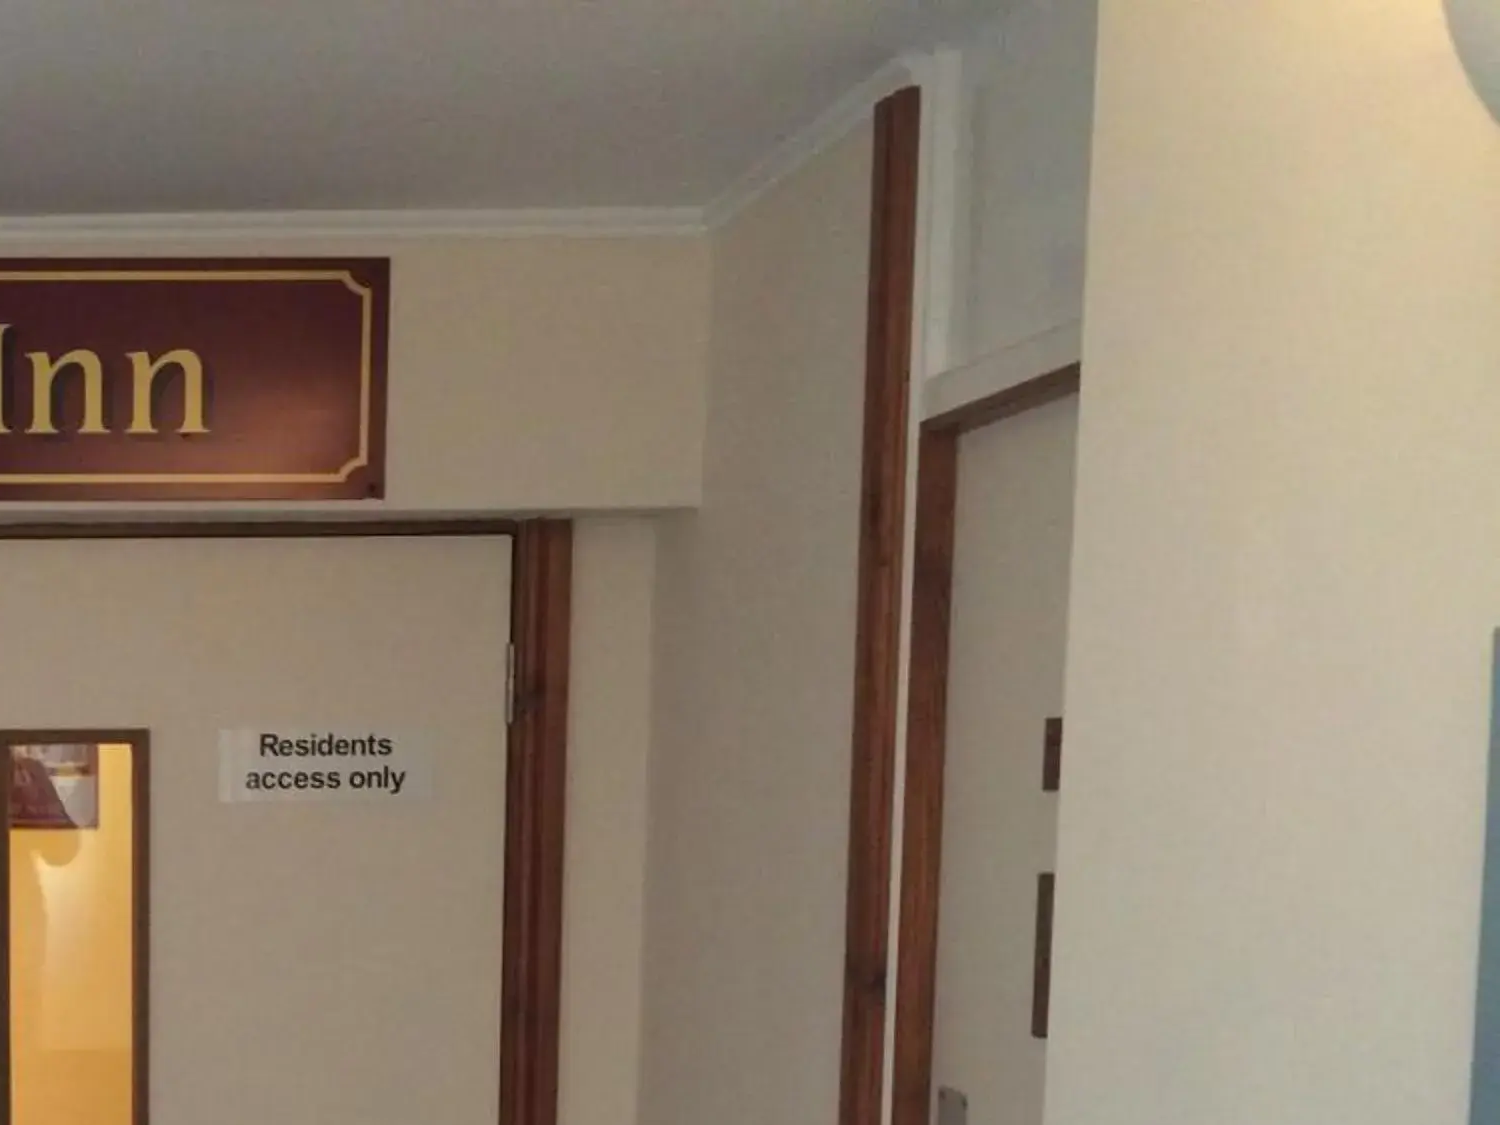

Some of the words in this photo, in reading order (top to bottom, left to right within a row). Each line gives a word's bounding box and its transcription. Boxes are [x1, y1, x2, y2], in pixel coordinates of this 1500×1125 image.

[259, 732, 394, 758] Residents
[245, 770, 342, 790] access
[348, 765, 407, 795] only
